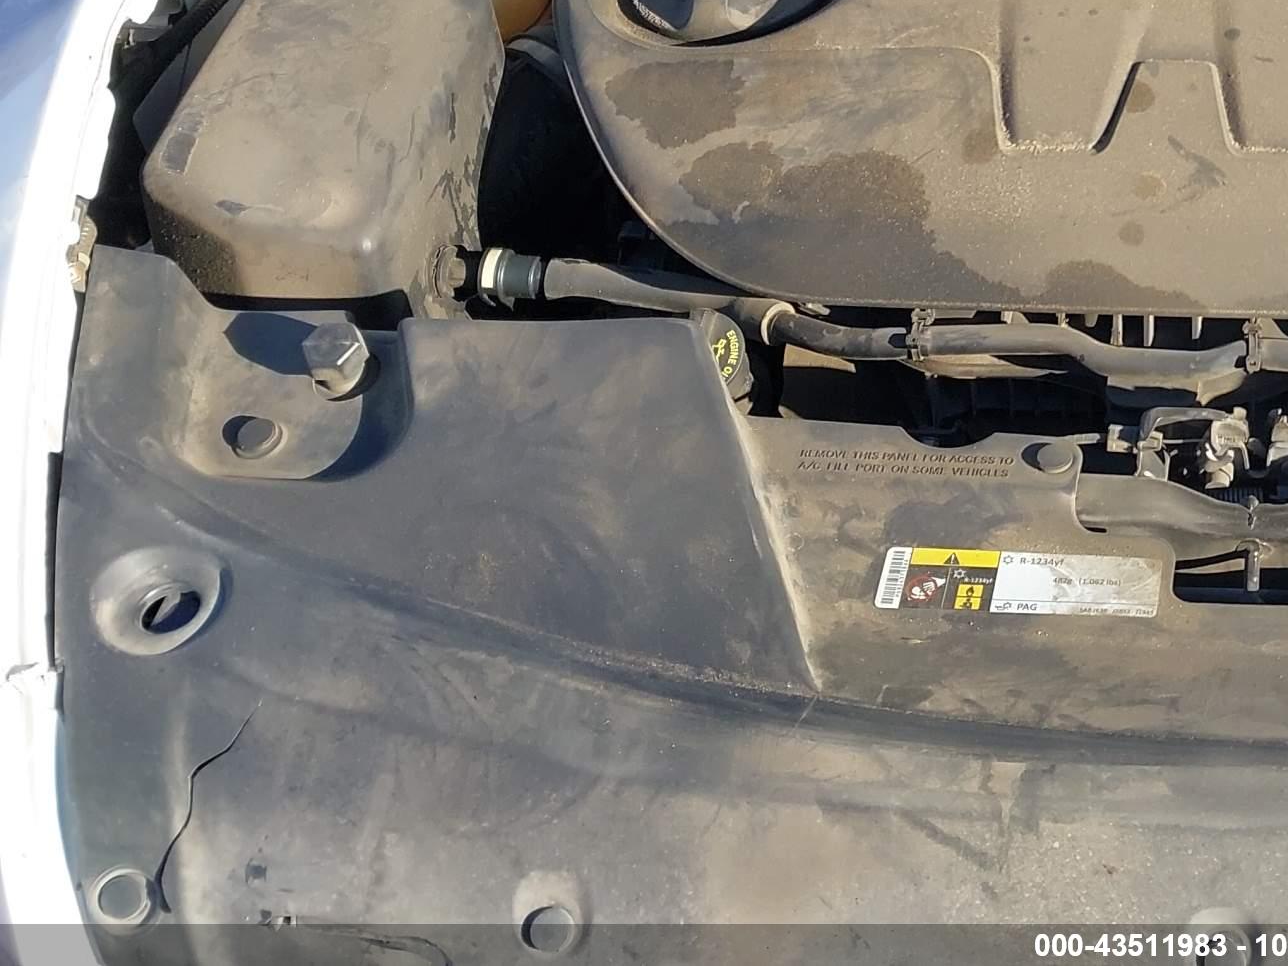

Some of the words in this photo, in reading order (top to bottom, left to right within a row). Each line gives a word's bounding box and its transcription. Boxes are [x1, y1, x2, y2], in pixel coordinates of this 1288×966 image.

[726, 329, 739, 366] ENGINE
[721, 366, 733, 380] OI
[799, 449, 847, 459] REMOVE
[853, 450, 880, 460] THIS
[882, 451, 919, 462] PANEL
[922, 453, 947, 463] FOR
[949, 454, 996, 465] ACCESS
[999, 456, 1015, 466] TO
[798, 461, 821, 471] A/C
[826, 462, 849, 471] FILL
[855, 463, 885, 473] PORT
[891, 464, 910, 474] ON
[911, 465, 944, 475] SOME
[951, 467, 1009, 478] VEHICLES
[1020, 557, 1065, 567] R-1234yf
[1017, 603, 1038, 612] PAG
